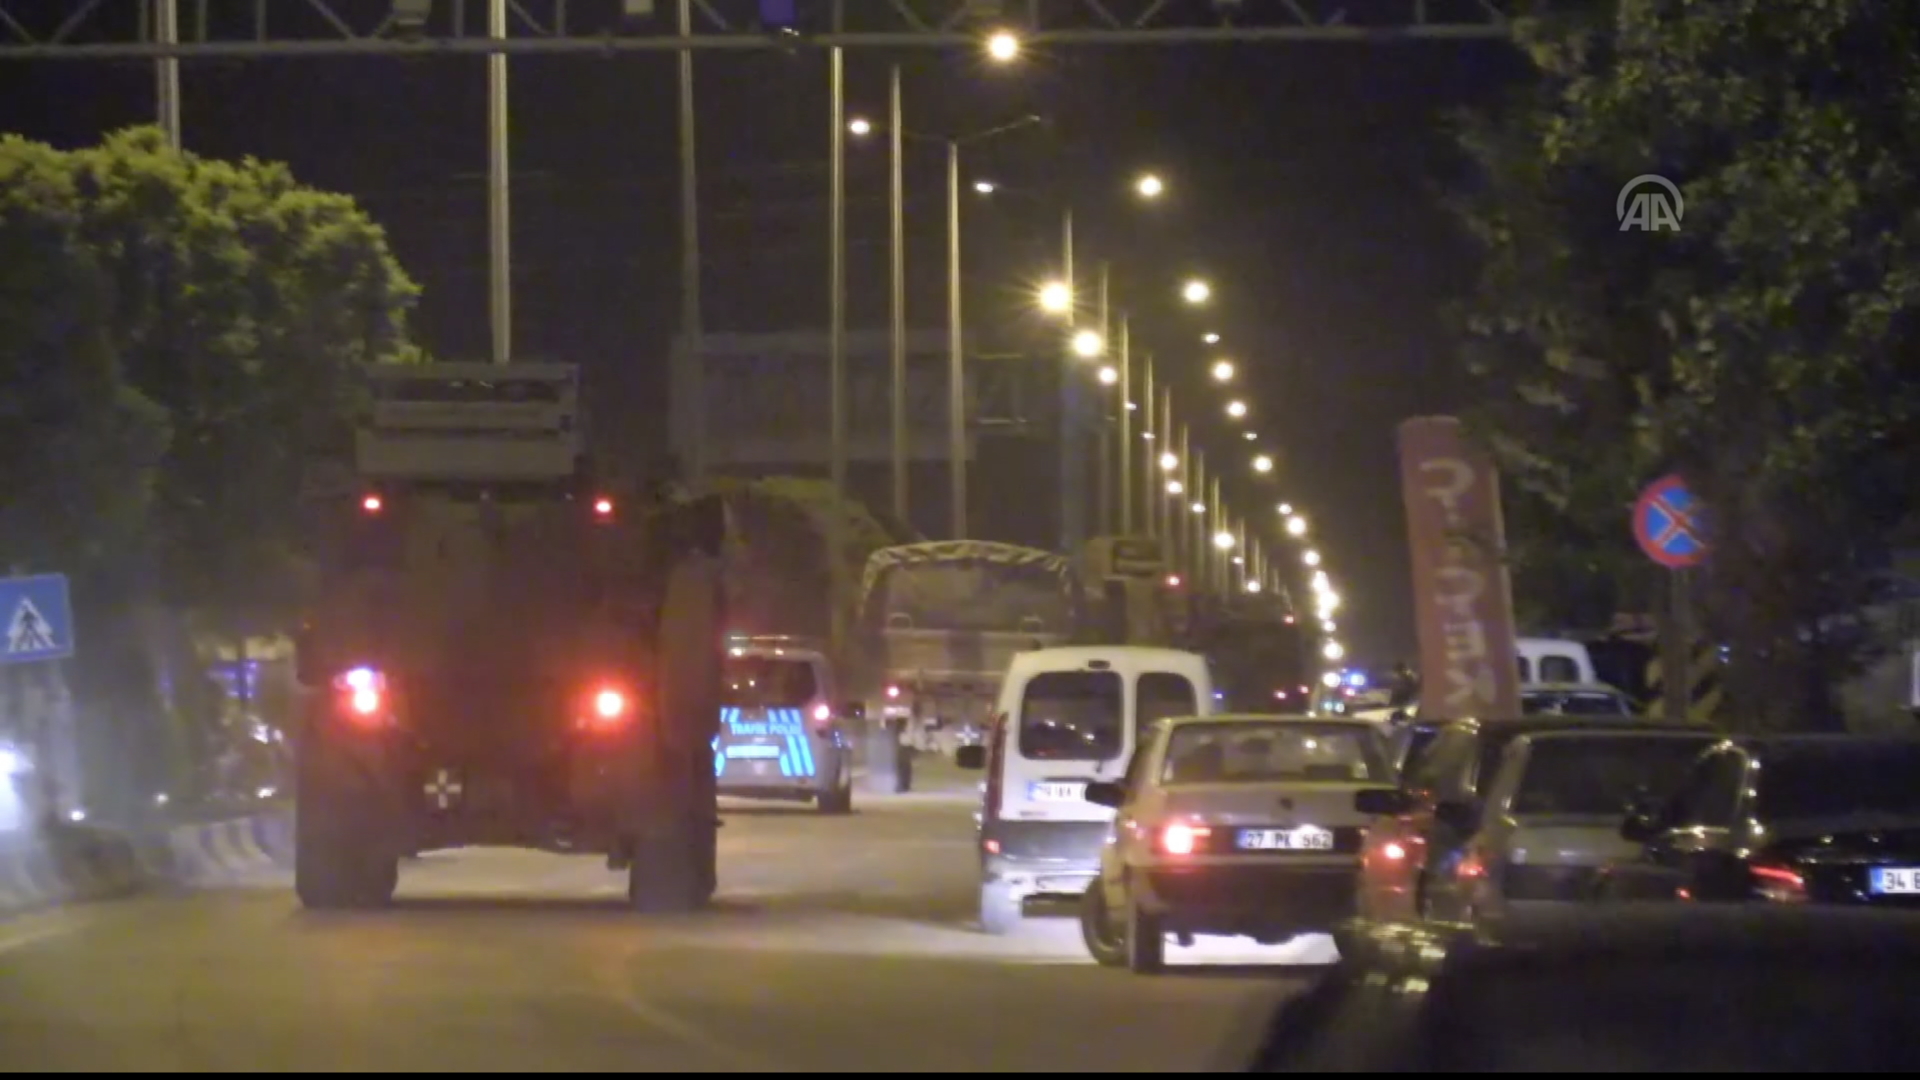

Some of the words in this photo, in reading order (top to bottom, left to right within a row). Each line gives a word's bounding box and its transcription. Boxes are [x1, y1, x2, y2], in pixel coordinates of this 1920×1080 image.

[1247, 832, 1264, 847] 27
[1302, 833, 1331, 848] 562
[1885, 872, 1906, 889] 34
